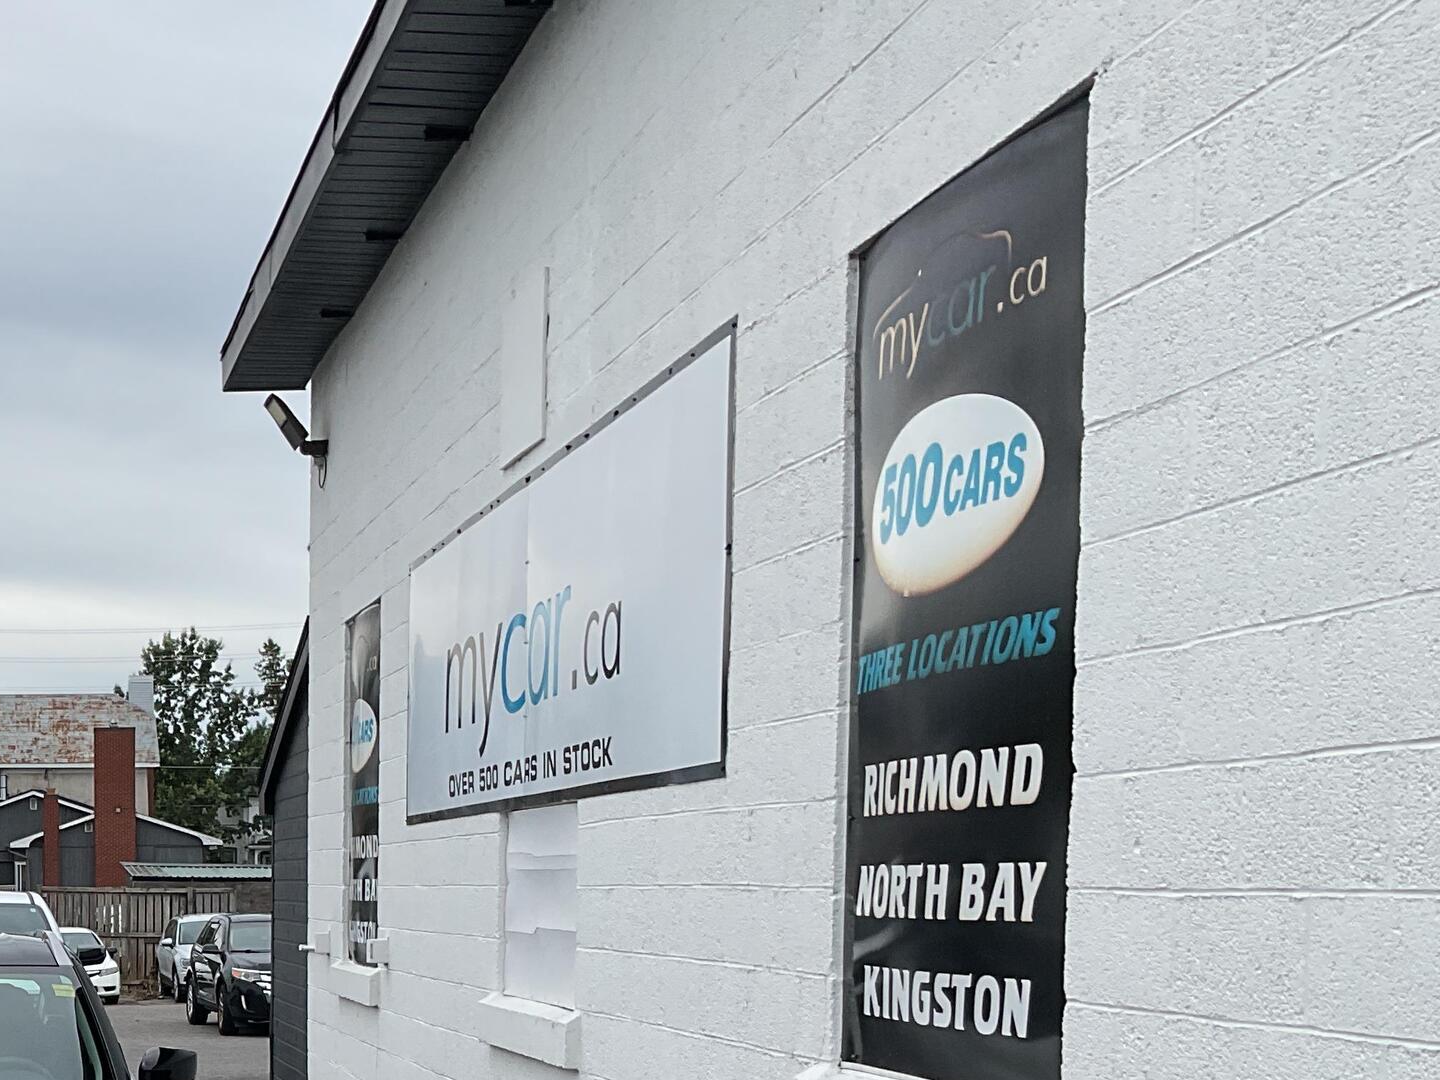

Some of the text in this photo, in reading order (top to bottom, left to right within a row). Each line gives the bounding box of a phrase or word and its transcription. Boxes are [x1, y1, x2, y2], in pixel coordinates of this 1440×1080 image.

[445, 584, 622, 758] mycar.ca
[857, 607, 1061, 695] THREE LOCATIONS
[448, 736, 613, 798] OVER 500 CARS IN STOCK
[863, 743, 1044, 817] RICHMOND
[855, 861, 1048, 922] NORTH BAY
[863, 964, 1031, 1039] KINGSTON
